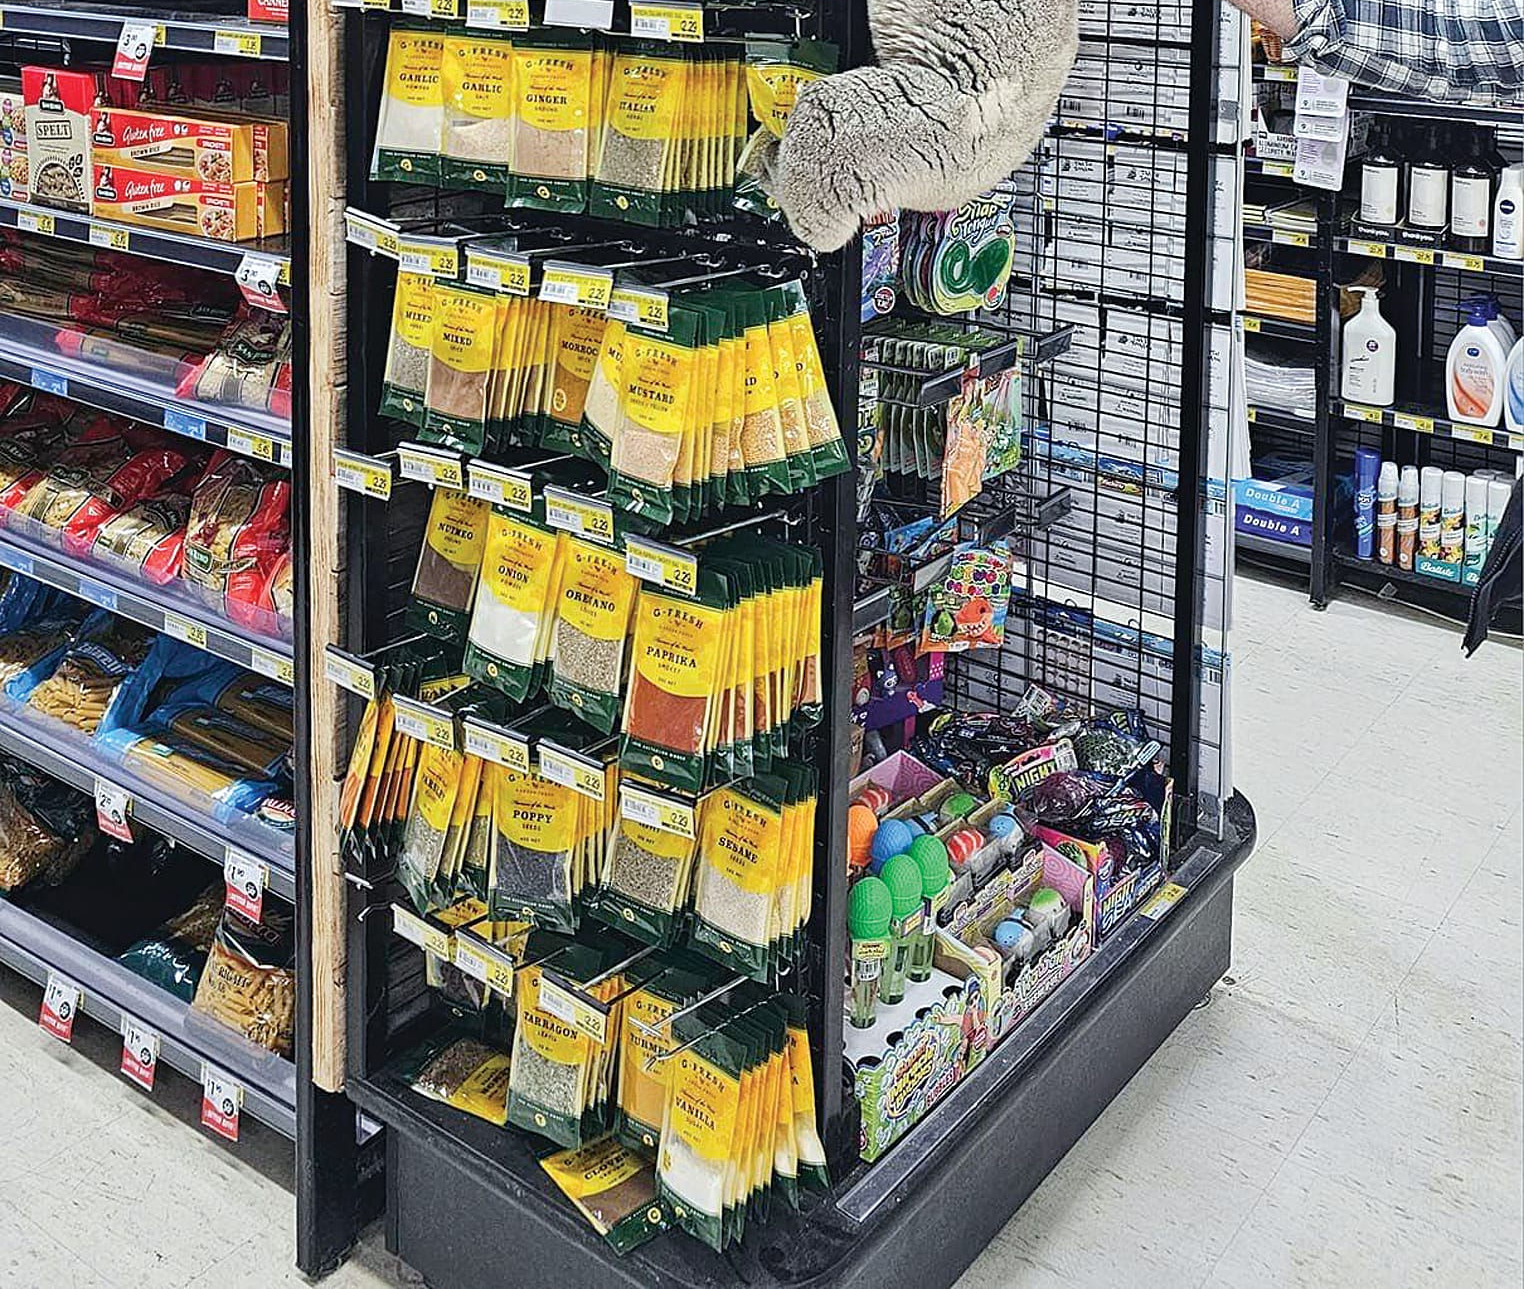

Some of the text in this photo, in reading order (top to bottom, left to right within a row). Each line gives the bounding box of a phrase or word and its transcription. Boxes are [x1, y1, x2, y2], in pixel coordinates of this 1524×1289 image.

[399, 73, 439, 84] GARLIC
[462, 82, 503, 94] GARLIC
[526, 94, 567, 105] GINGER
[37, 122, 70, 137] SPELT
[405, 311, 432, 323] MIXED
[442, 332, 472, 347] MIXED
[628, 385, 675, 405] MUSTARD
[1245, 487, 1300, 508] Double A
[1243, 515, 1300, 536] Double A
[498, 566, 529, 584] ONION
[646, 646, 698, 669] PAPRIKA
[1012, 760, 1058, 793] NIGHT
[512, 810, 553, 824] POPPY
[718, 836, 758, 864] SESAME
[524, 1010, 579, 1040] TARRAGON
[674, 1096, 716, 1131] VANILLA
